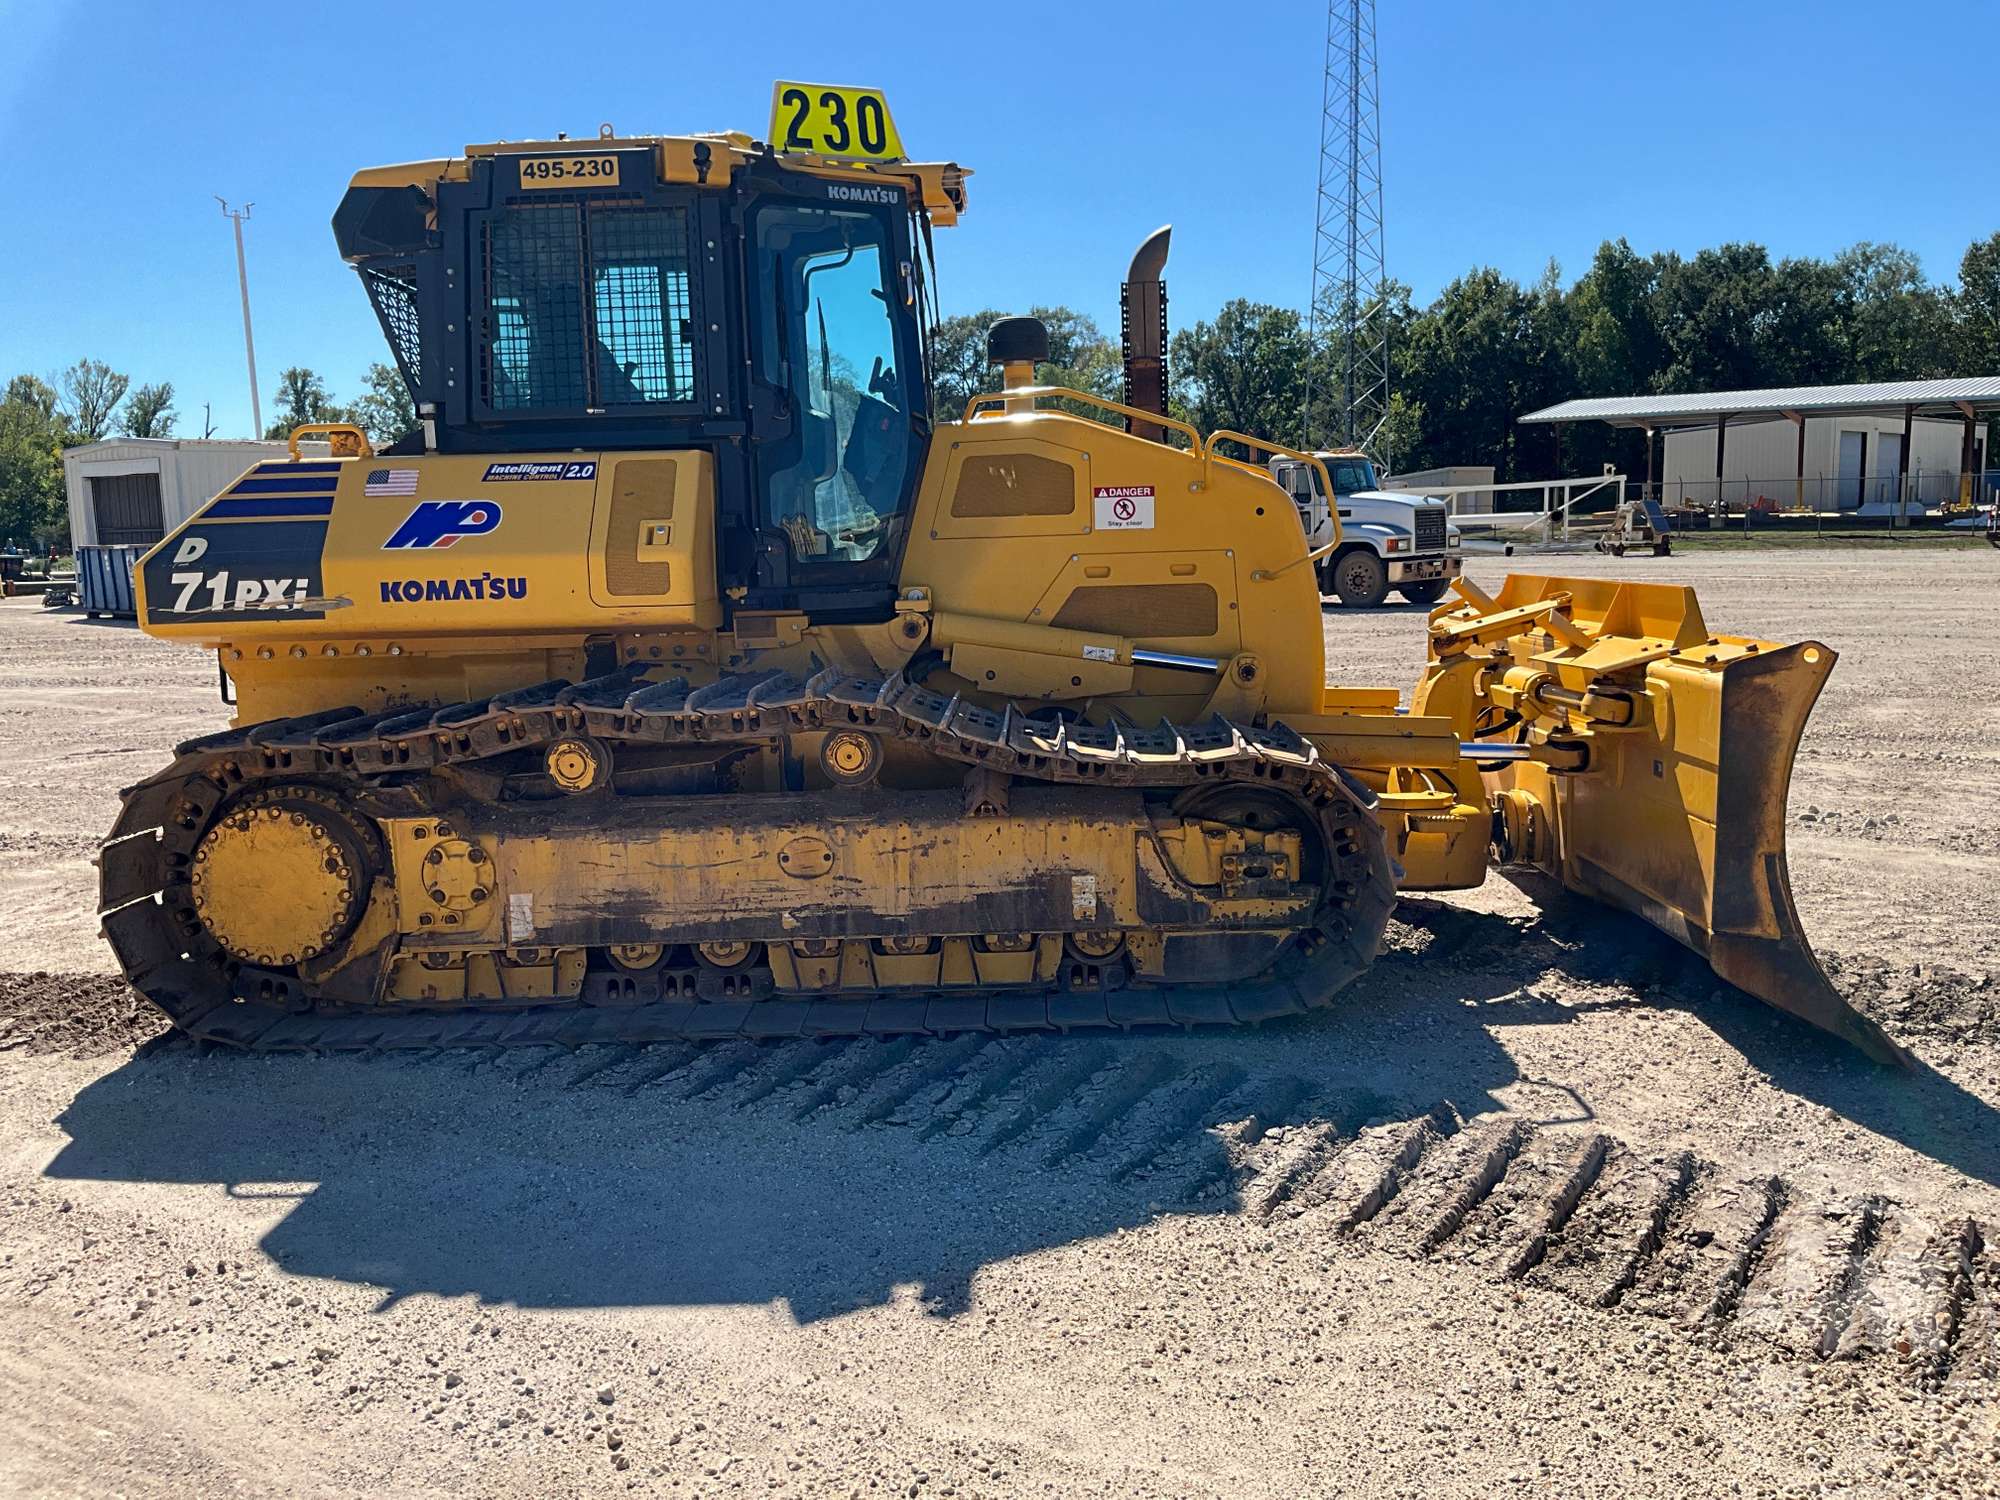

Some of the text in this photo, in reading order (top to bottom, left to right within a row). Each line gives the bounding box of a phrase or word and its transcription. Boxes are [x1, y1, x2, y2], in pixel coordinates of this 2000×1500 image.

[782, 88, 886, 155] 230
[522, 159, 615, 179] 495-230
[828, 185, 898, 204] KOMATSU
[486, 473, 558, 481] MACHINE CONTROL
[566, 465, 594, 478] 2.0
[1109, 487, 1151, 497] DANGER
[173, 537, 209, 563] D
[380, 572, 527, 602] KOMATSU
